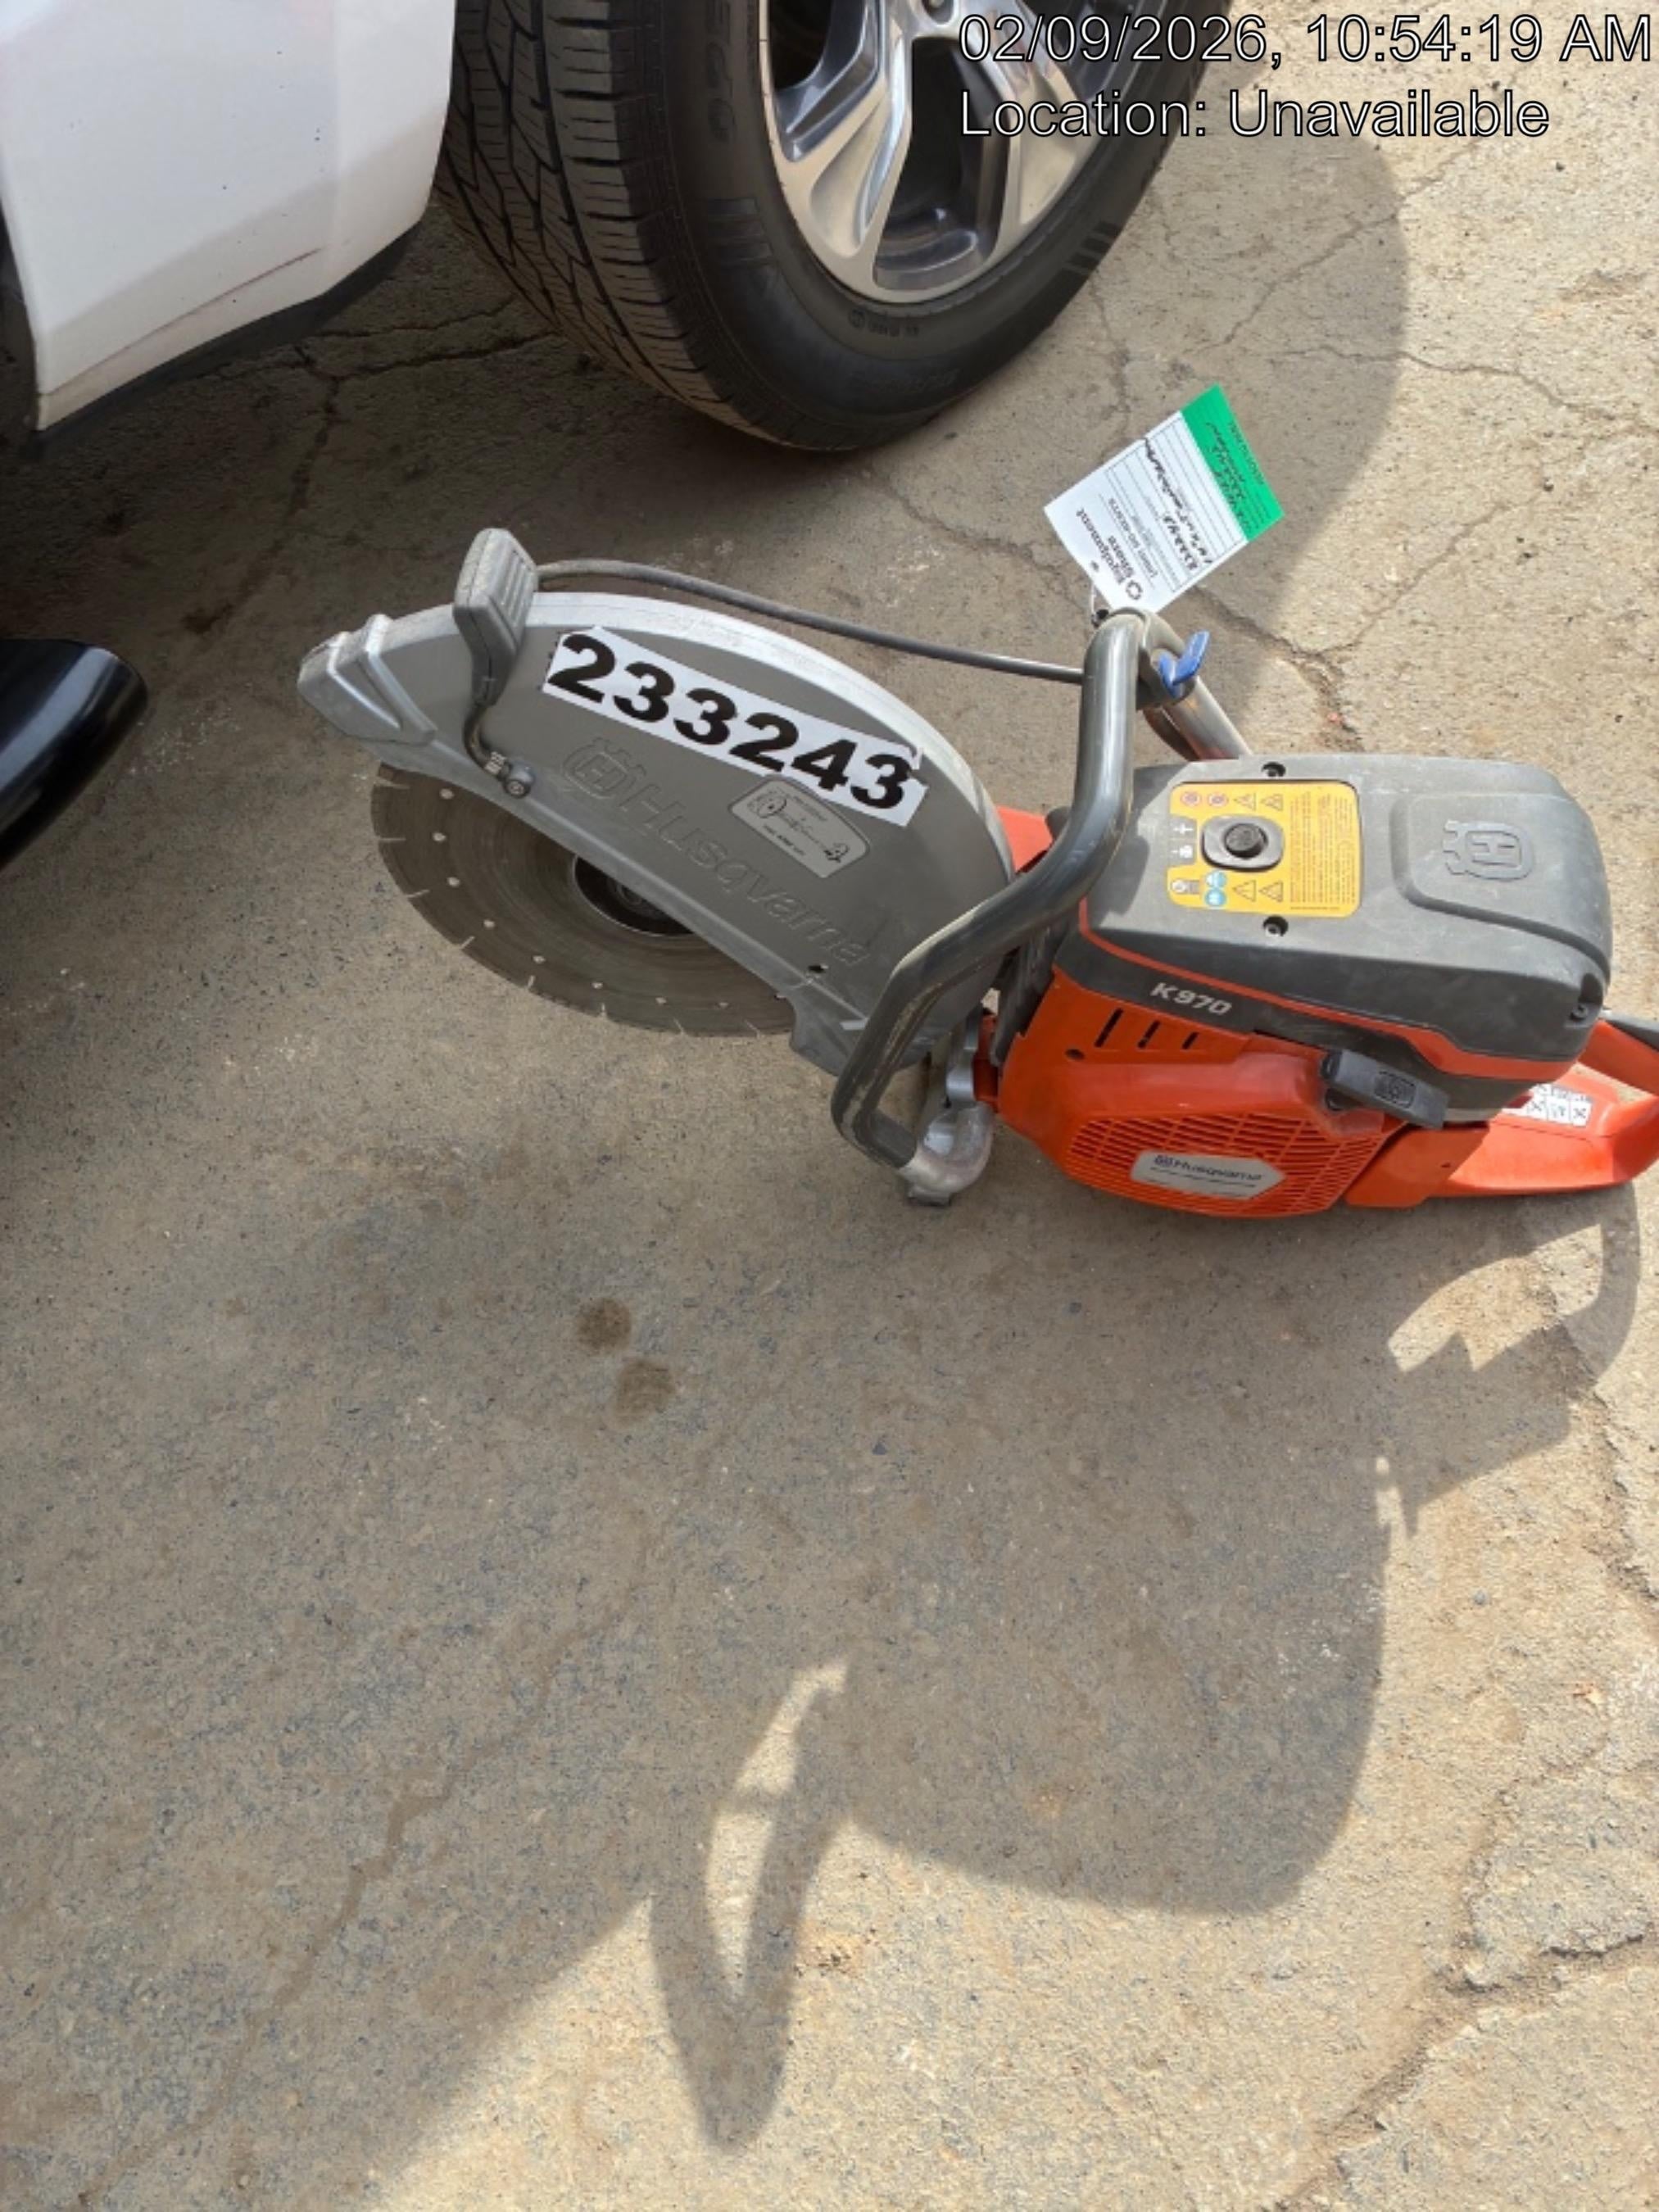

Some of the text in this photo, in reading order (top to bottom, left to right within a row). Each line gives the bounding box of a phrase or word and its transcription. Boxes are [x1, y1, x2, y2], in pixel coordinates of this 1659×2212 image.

[1075, 508, 1126, 584] Equipment
[547, 633, 913, 809] 233243
[617, 782, 870, 965] Husqvarna
